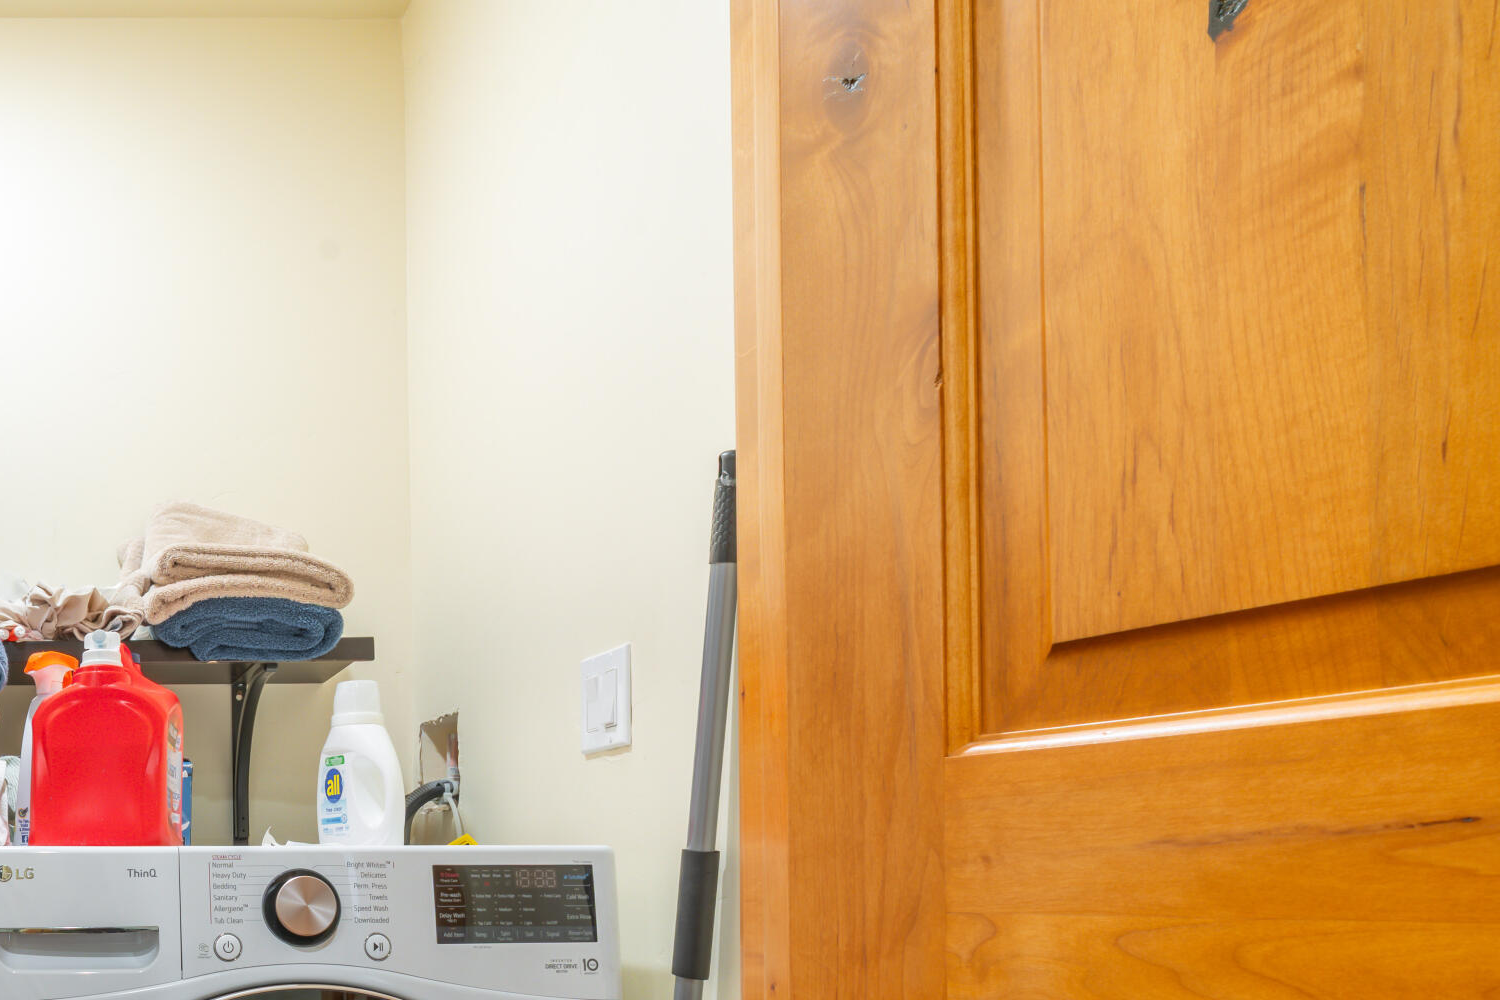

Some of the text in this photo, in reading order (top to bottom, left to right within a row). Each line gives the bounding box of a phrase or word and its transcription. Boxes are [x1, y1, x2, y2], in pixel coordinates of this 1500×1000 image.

[327, 774, 340, 796] all
[346, 861, 364, 869] Bright
[15, 867, 35, 880] LG
[127, 868, 157, 878] ThinQ
[212, 883, 237, 891] Bedding
[213, 894, 238, 902] Sanitary
[582, 958, 599, 972] 10
